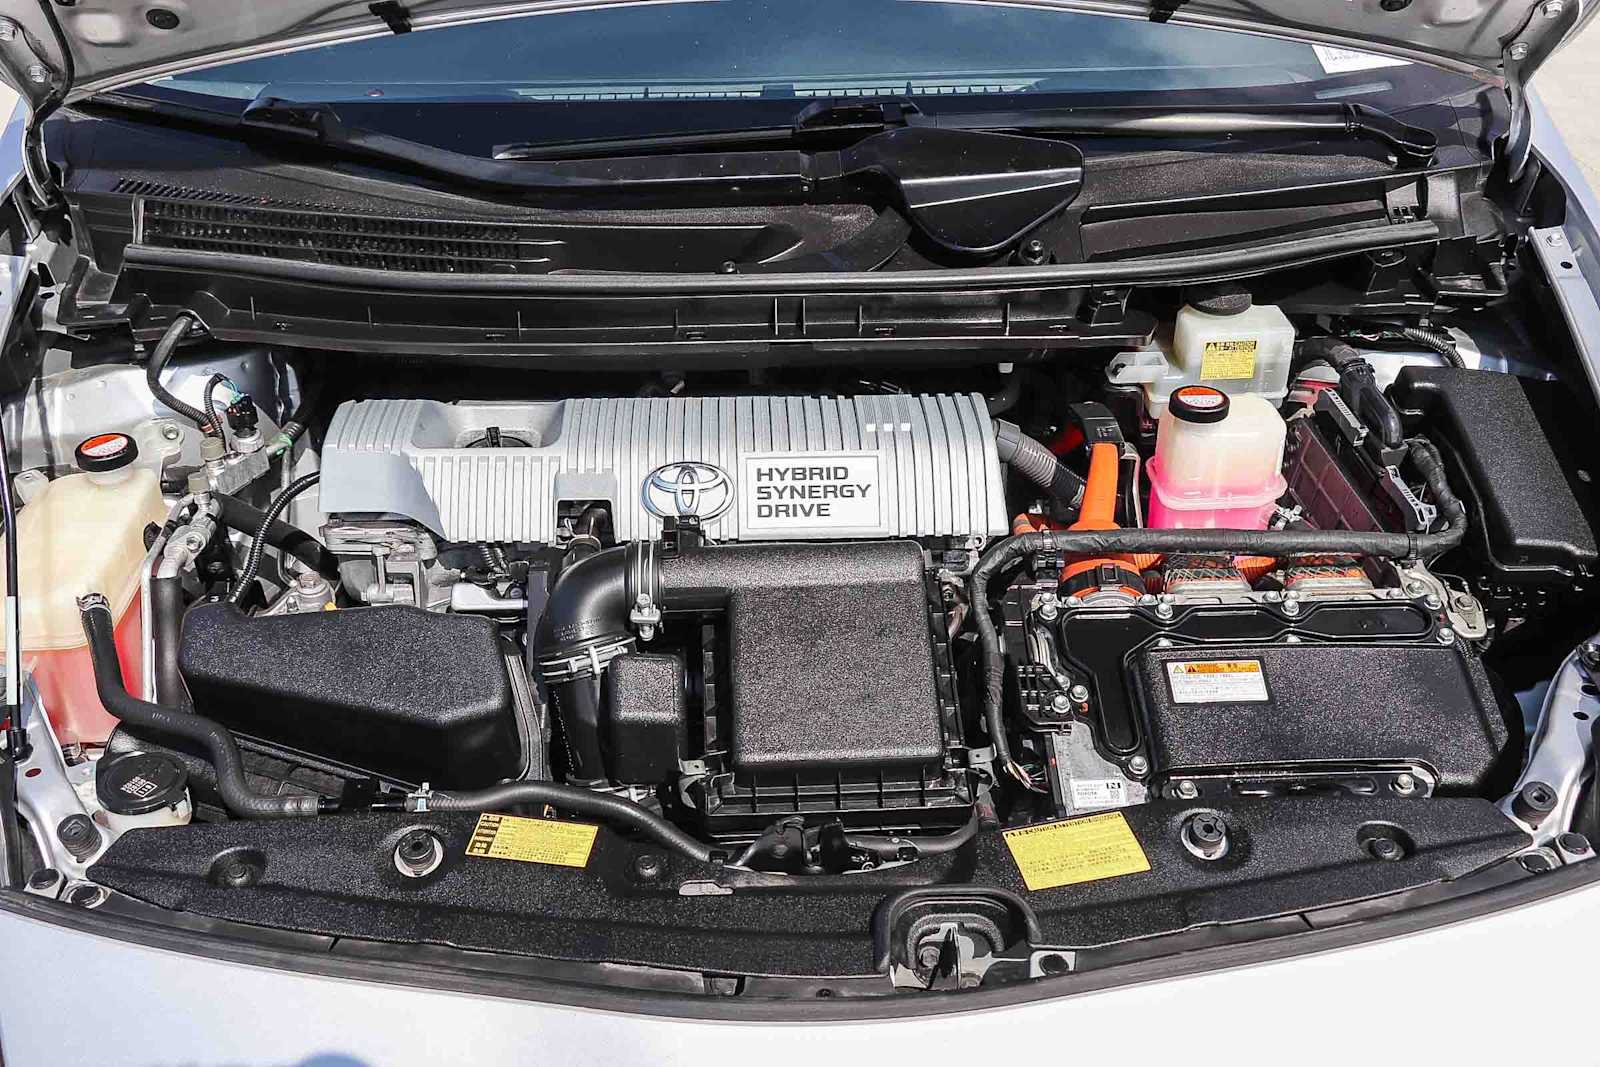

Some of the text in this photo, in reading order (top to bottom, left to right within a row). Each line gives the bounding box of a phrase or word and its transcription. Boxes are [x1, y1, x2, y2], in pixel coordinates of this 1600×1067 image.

[756, 466, 848, 481] HYBRID
[756, 484, 871, 500] SYNERGY
[757, 503, 831, 518] DRIVE
